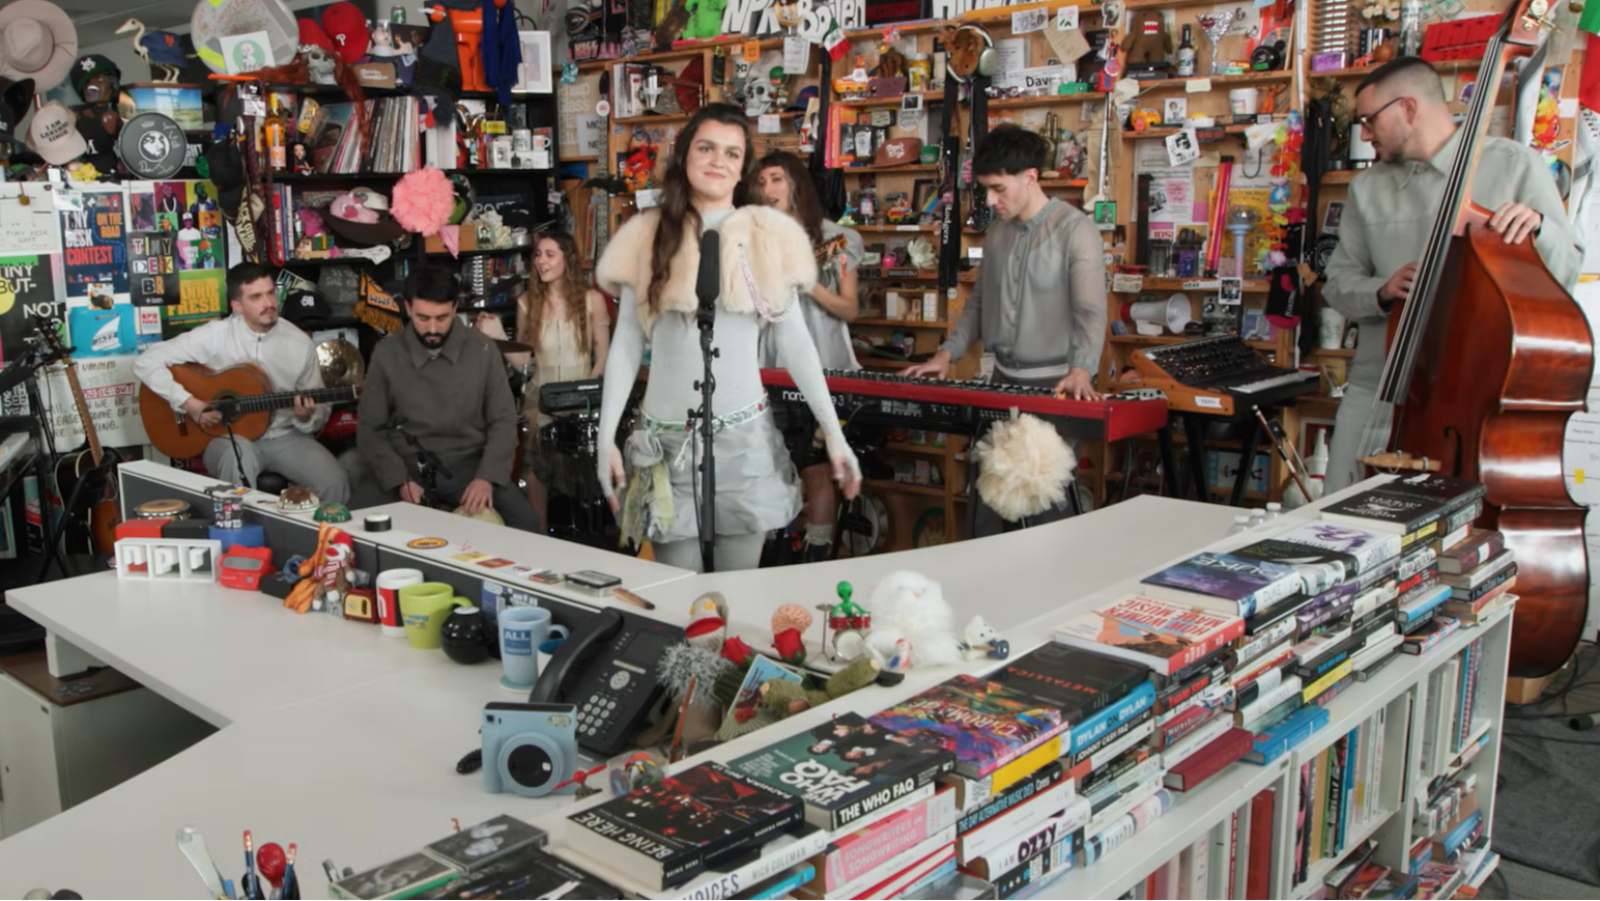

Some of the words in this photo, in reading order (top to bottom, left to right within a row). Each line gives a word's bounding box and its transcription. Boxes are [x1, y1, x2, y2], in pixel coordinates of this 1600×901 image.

[558, 98, 590, 114] Glass
[962, 158, 973, 184] VIP
[66, 246, 113, 266] CONTEST
[132, 236, 172, 256] TINY
[23, 302, 60, 319] NOT
[124, 545, 205, 575] npr
[1191, 555, 1286, 579] DUKE
[1263, 583, 1282, 599] DUKE
[1103, 606, 1166, 628] WOMEN
[1120, 599, 1175, 619] MUSIC
[1175, 612, 1226, 628] MADE
[504, 630, 530, 642] ALL
[1162, 620, 1211, 637] HOW
[1007, 666, 1098, 694] METALLICA
[1077, 719, 1106, 746] DYLAN
[1106, 713, 1120, 729] ON
[1118, 696, 1147, 720] DYLAN
[1076, 739, 1101, 763] JOHNNY
[1101, 730, 1118, 746] CASH
[779, 771, 843, 802] WHO
[793, 758, 871, 793] FAQ
[801, 791, 831, 807] THE
[839, 803, 861, 824] THE
[863, 788, 890, 812] WHO
[893, 778, 915, 797] FAQ
[958, 817, 969, 834] THE
[968, 813, 978, 829] DAY
[978, 797, 1009, 825] ALTERNATIVE
[1023, 782, 1035, 801] DIED
[574, 812, 624, 837] HERE
[621, 831, 675, 860] BEING
[843, 817, 912, 863] SONGWRITERS
[848, 829, 917, 875] SONGWRITING
[1004, 854, 1015, 868] AM
[1017, 823, 1058, 864] OZZY
[752, 862, 772, 881] NICK
[771, 846, 807, 873] COLEMAN
